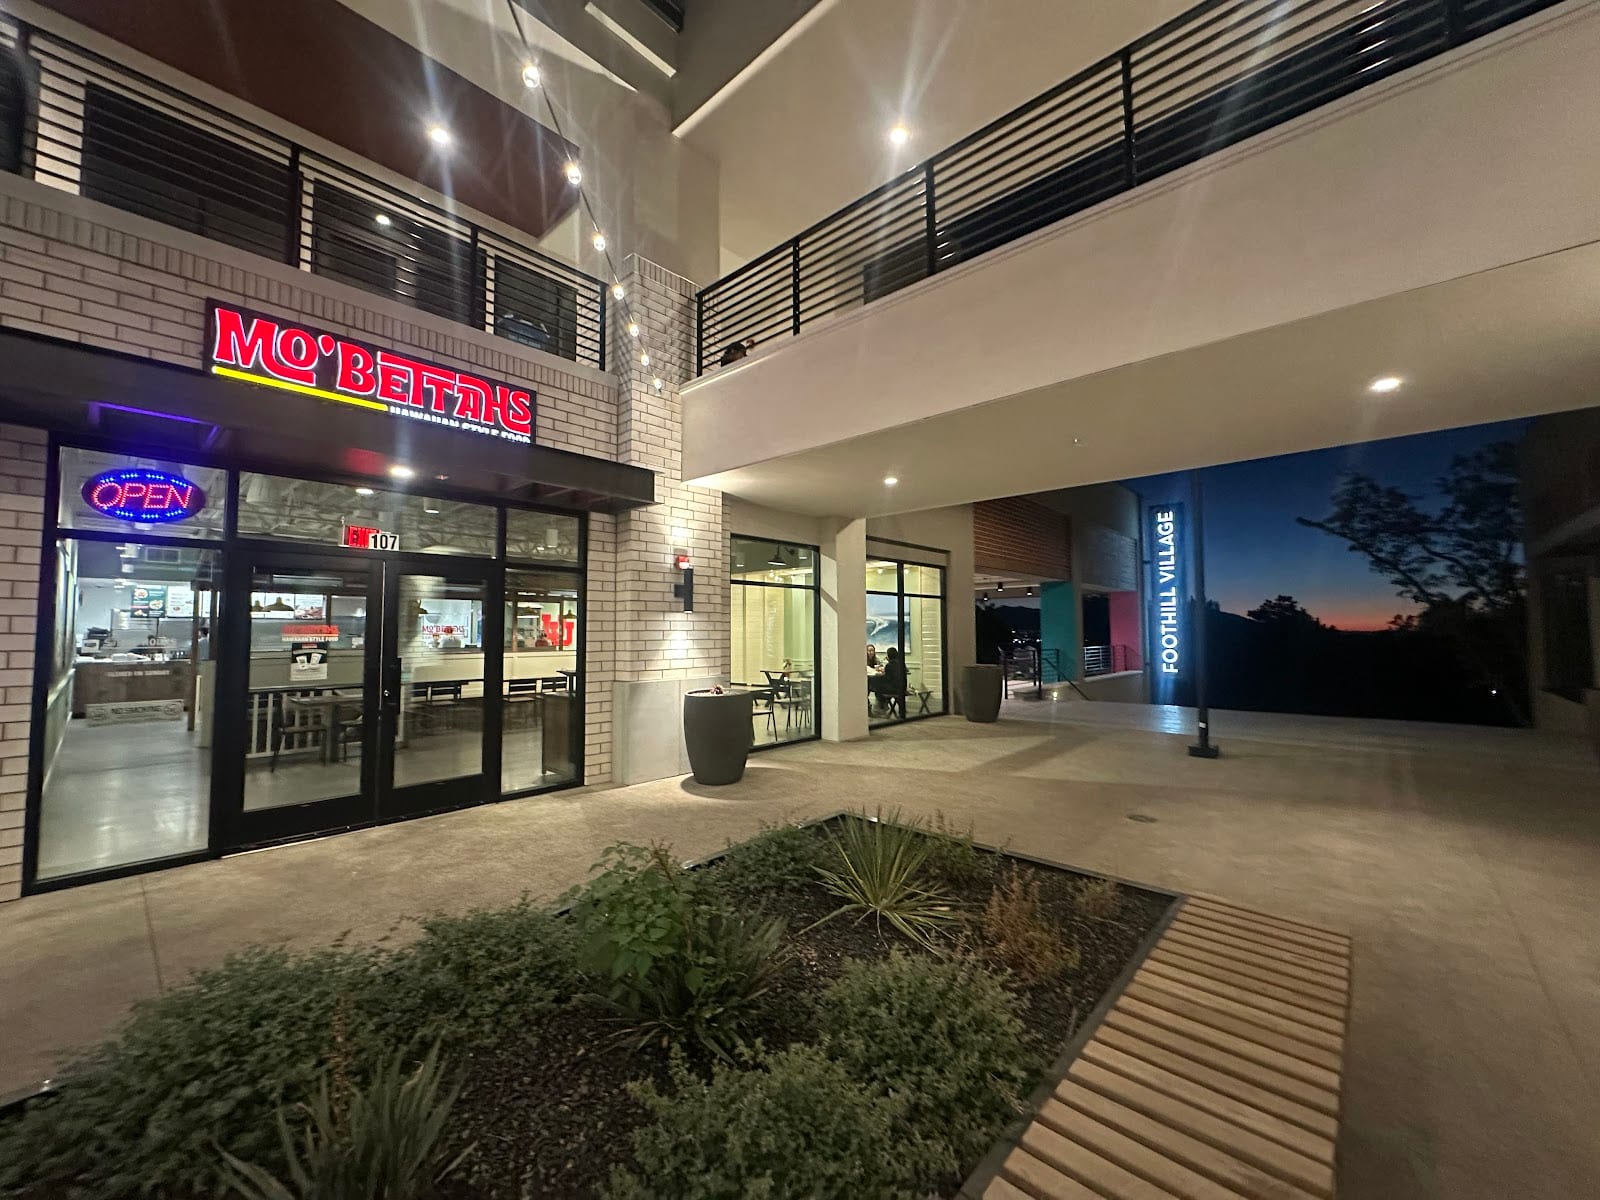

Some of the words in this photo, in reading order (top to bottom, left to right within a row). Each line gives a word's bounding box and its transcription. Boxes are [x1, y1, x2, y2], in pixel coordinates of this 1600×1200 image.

[92, 482, 193, 509] OPEN
[371, 534, 397, 549] 107
[1157, 510, 1175, 584] VILLAGE
[1160, 586, 1179, 673] FOOTHILL
